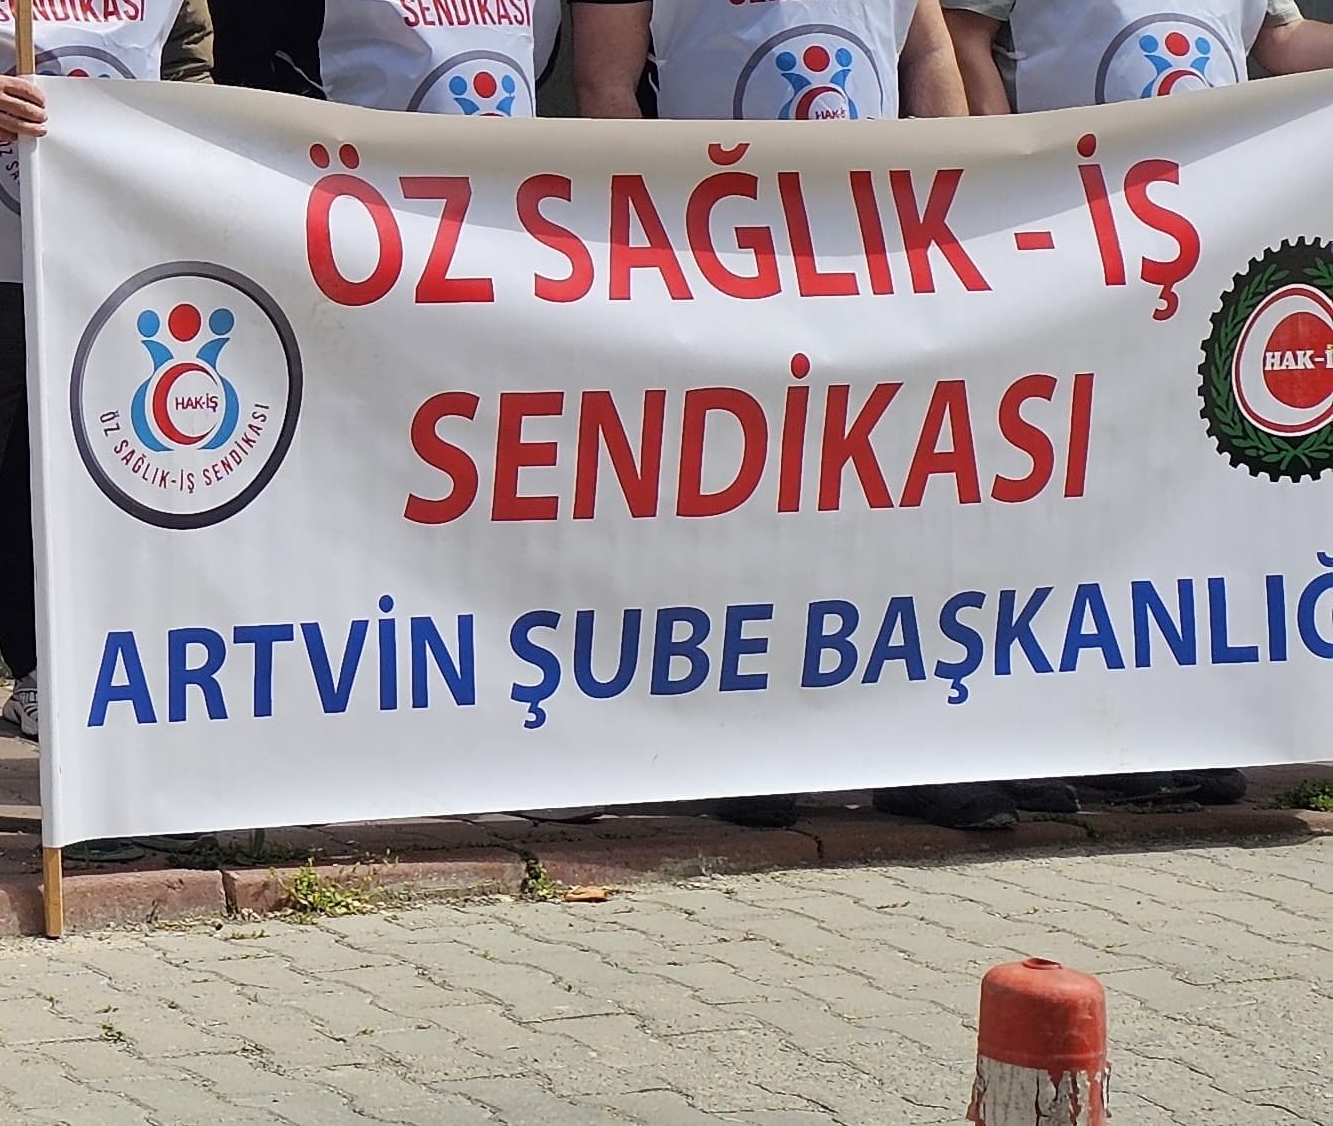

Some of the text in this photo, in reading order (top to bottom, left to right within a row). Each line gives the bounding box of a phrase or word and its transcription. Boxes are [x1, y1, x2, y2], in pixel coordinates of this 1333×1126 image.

[306, 143, 495, 306] ÖZ
[516, 142, 991, 303] SAĞLIK
[1078, 134, 1201, 321] İŞ
[100, 403, 270, 493] ÖZ SAĞLIK-İŞ SENDİKASI
[175, 392, 219, 413] HAK-İŞ
[403, 353, 1095, 525] SENDİKASI
[87, 594, 476, 727] ARTVİN
[509, 603, 774, 730] ŞUBE
